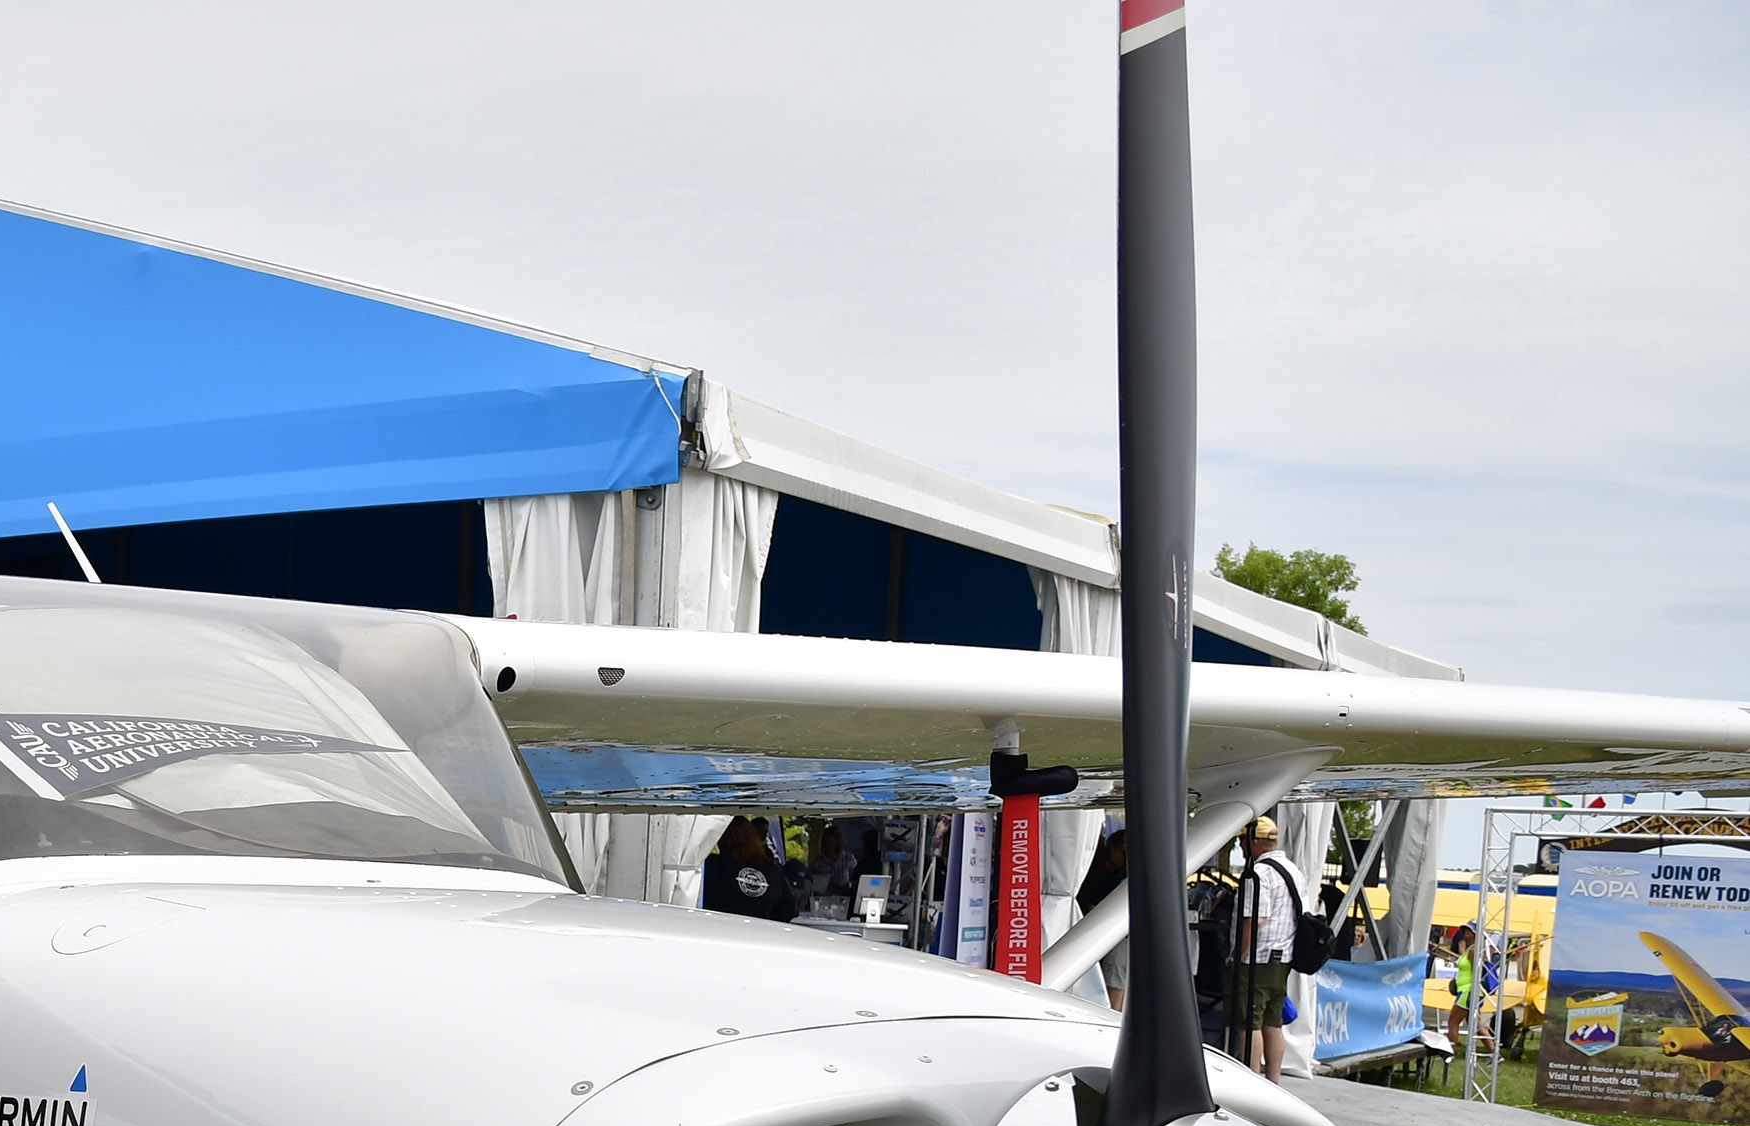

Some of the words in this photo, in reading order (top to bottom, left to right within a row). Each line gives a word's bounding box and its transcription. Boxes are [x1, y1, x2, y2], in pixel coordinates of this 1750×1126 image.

[41, 720, 240, 738] CALIFORNIA
[11, 733, 64, 769] CAU
[66, 730, 294, 755] AERONAUTICAL
[79, 739, 257, 774] UNIVERSITY
[1011, 819, 1028, 884] REMOVE
[1651, 865, 1693, 880] JOIN
[1697, 867, 1721, 882] OR
[1570, 880, 1640, 899] AOPA
[1649, 884, 1711, 900] RENEW
[1716, 887, 1750, 902] TOD
[1009, 888, 1028, 949] BEFORE
[1317, 1001, 1349, 1045] AOPA
[1384, 995, 1416, 1034] AOPA
[1549, 1071, 1568, 1080] Visit
[1592, 1076, 1618, 1084] booth
[1620, 1078, 1640, 1087] 463,
[1588, 1065, 1614, 1073] chance
[1592, 1085, 1604, 1093] the
[1606, 1086, 1631, 1095] Brown
[1633, 1089, 1651, 1097] Arch
[1665, 1091, 1679, 1099] the
